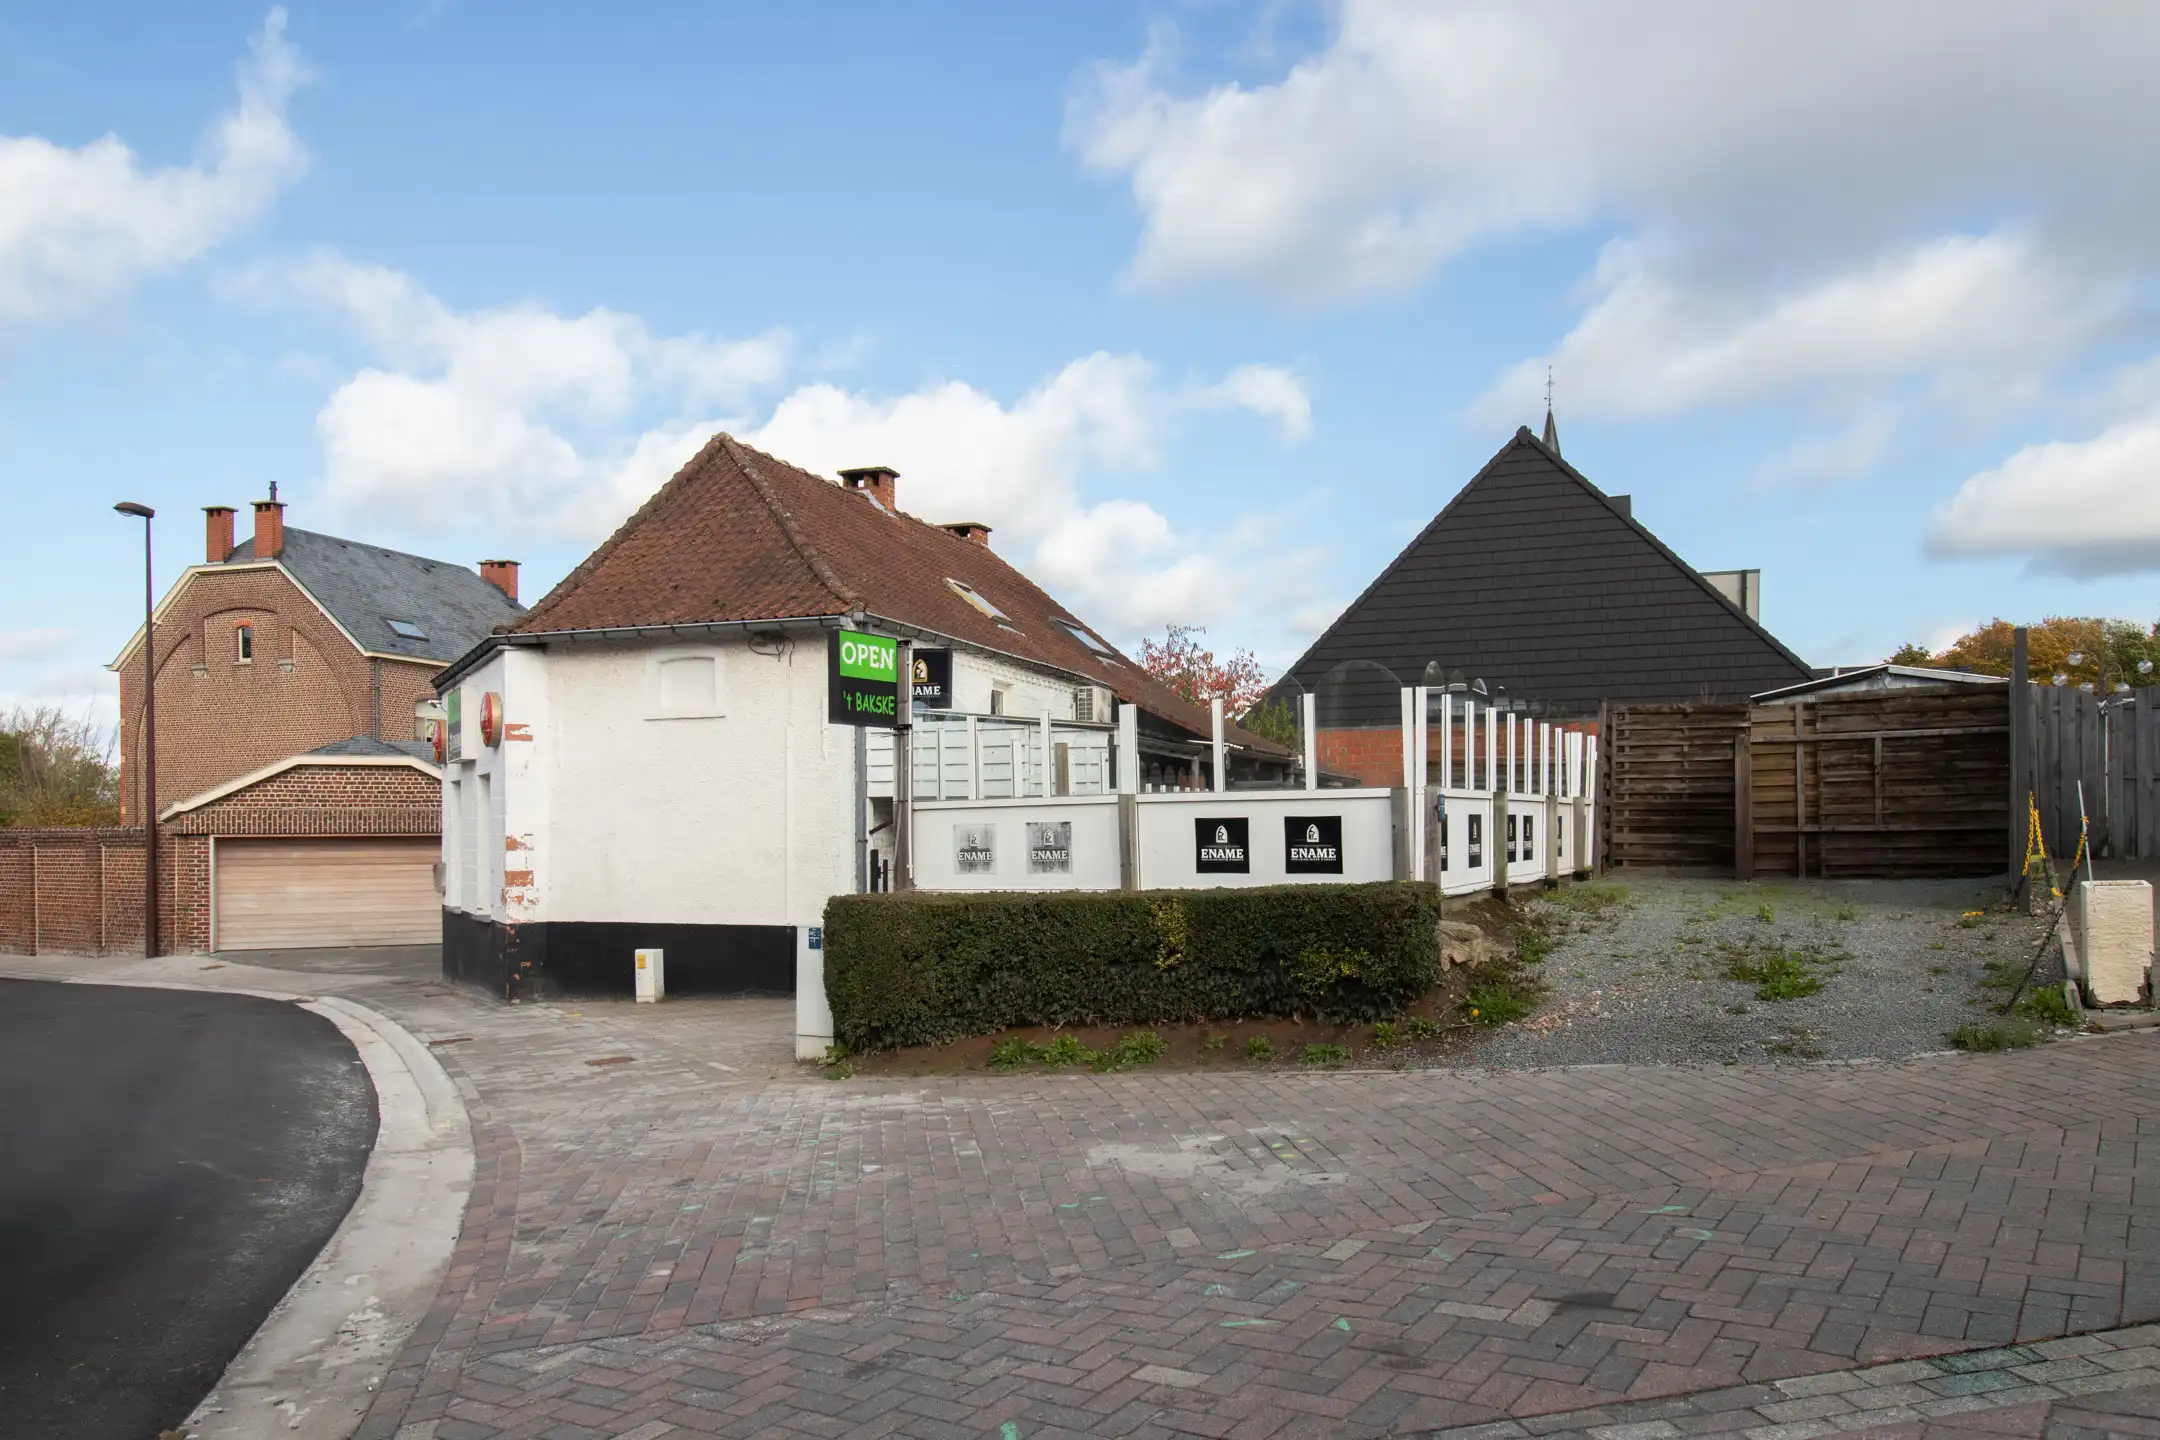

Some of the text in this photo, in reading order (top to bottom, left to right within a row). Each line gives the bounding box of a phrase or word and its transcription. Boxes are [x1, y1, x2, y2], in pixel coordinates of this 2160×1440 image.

[841, 641, 894, 670] OPEN
[912, 685, 941, 695] AME
[843, 690, 895, 715] 't BAKSKE
[958, 851, 993, 861] ENAME
[1031, 850, 1068, 860] ENAME
[1201, 848, 1244, 858] ENAME
[1290, 848, 1336, 858] ENAME
